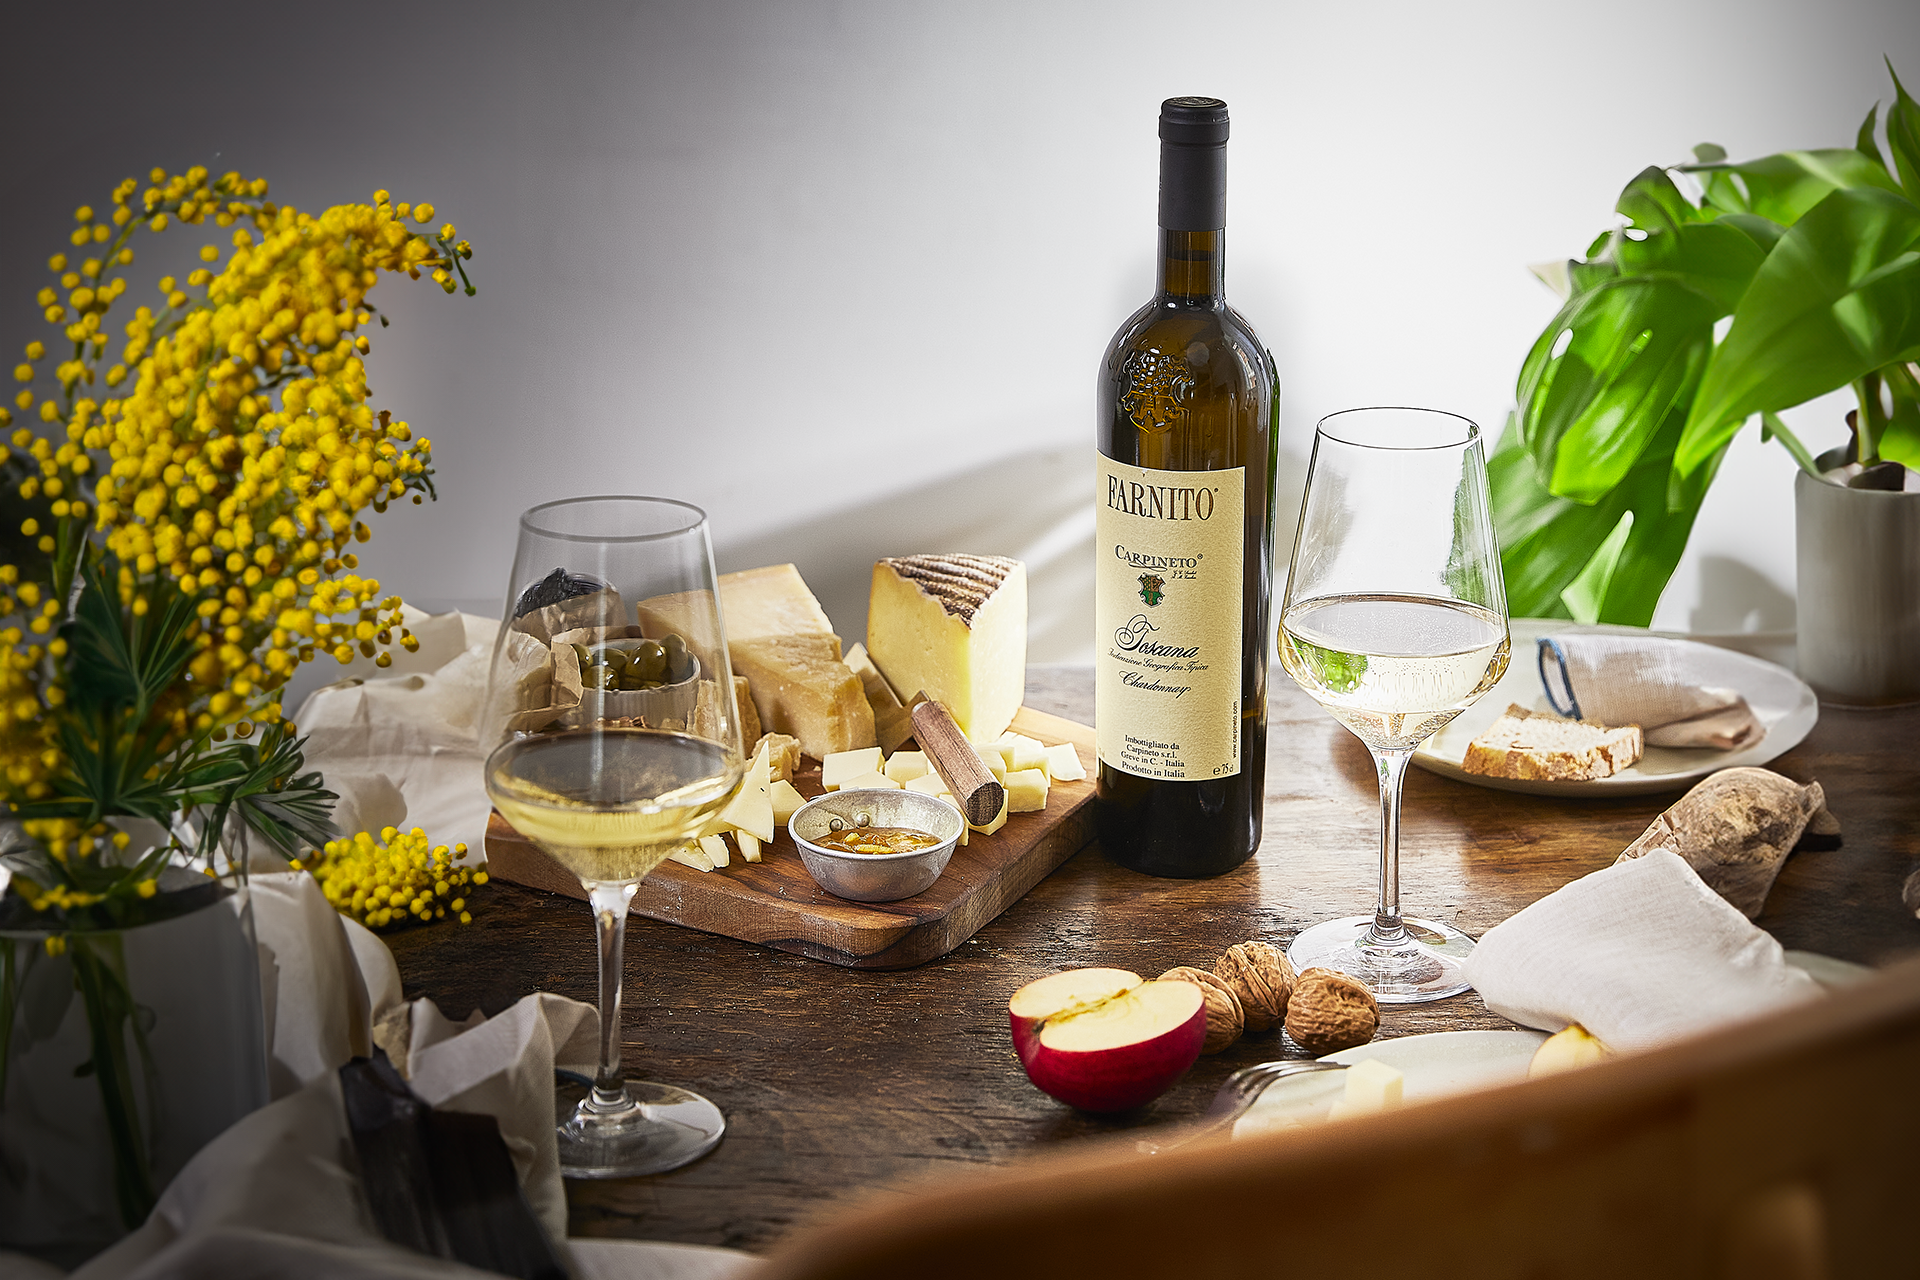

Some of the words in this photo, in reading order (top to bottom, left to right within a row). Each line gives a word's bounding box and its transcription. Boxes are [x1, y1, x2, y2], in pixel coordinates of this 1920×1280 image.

[1107, 474, 1214, 520] FARNITO
[1114, 614, 1200, 659] Toscana
[1119, 670, 1191, 699] Chardonnay
[1124, 734, 1169, 750] Imbottigliato
[1126, 744, 1160, 758] Carpineto
[1120, 750, 1140, 763] Greve
[1141, 756, 1149, 764] in
[1165, 759, 1185, 768] Italia
[1121, 761, 1152, 775] Prodotto
[1153, 768, 1162, 777] in
[1164, 768, 1185, 778] Italia
